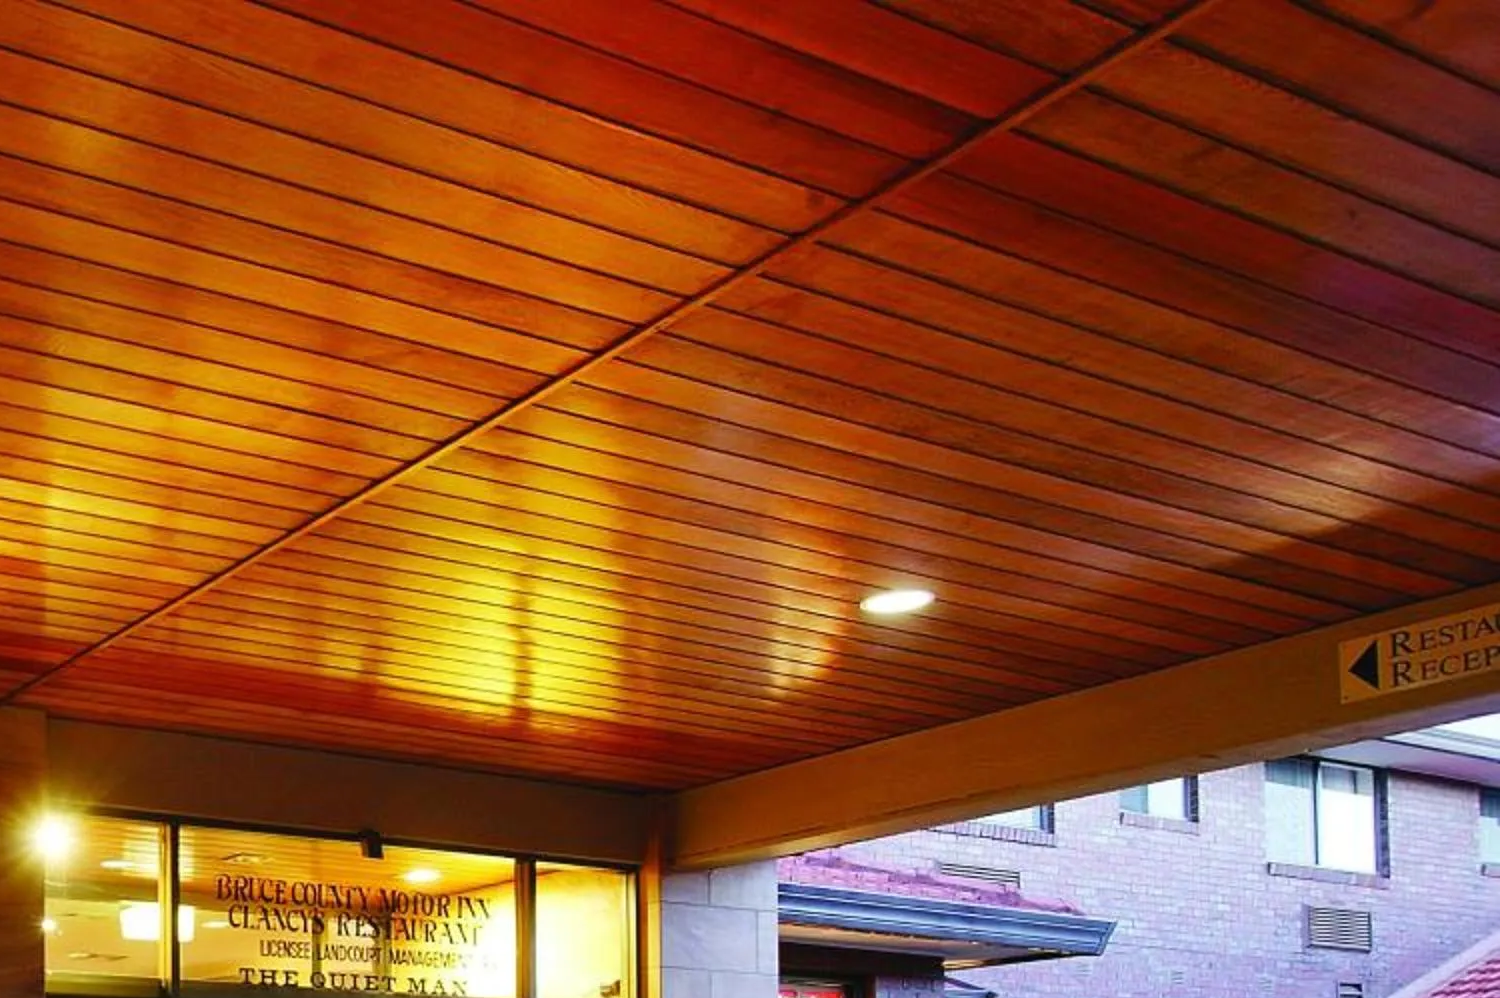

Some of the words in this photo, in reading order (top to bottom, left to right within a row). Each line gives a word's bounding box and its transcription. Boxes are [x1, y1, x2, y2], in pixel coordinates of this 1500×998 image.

[216, 873, 287, 905] BRUCE
[291, 881, 370, 911] COUNTY
[379, 887, 451, 918] MOTOR
[457, 895, 492, 919] INN
[228, 903, 326, 935] CLANCY'S
[336, 911, 484, 946] RESTAURANT
[259, 940, 311, 959] LICENSEE
[238, 967, 299, 988] THE
[310, 971, 397, 992] QUIET
[407, 977, 468, 997] MAN
